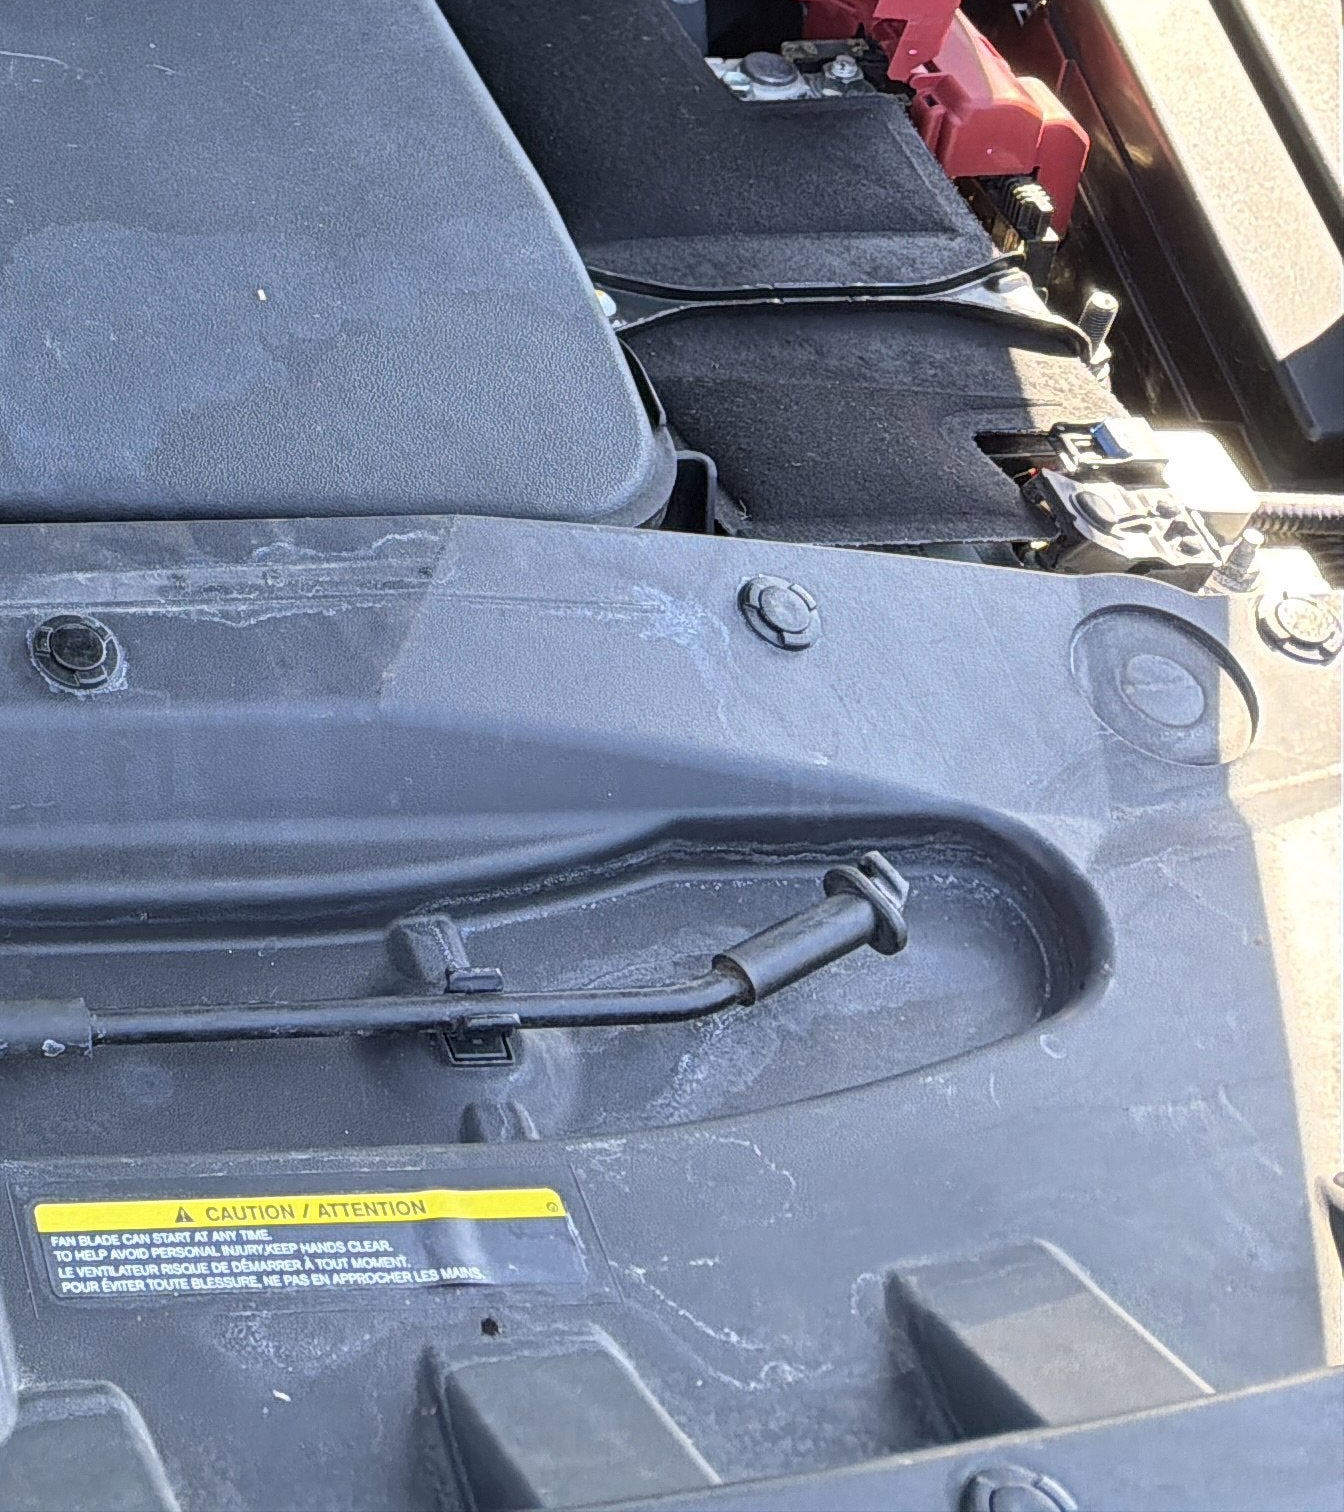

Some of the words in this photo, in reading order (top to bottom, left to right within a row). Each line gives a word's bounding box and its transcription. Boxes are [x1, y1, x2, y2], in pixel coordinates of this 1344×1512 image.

[205, 1203, 296, 1222] CAUTION
[318, 1199, 428, 1219] ATTENTION
[51, 1235, 76, 1248] FAN
[78, 1234, 120, 1246] BLADE
[122, 1233, 151, 1245] CAN
[152, 1231, 191, 1244] START
[194, 1231, 209, 1243] AT
[211, 1230, 237, 1242] ANY
[238, 1228, 273, 1241] TIME.
[53, 1250, 72, 1262] TO
[74, 1248, 108, 1261] HELP
[110, 1247, 150, 1261] AVOID
[151, 1245, 221, 1259] PERSONAL
[300, 1240, 347, 1255] HANDS
[347, 1239, 394, 1253] CLEAR.
[57, 1266, 75, 1279] LE
[75, 1263, 159, 1278] VENTILATEUR
[160, 1261, 210, 1276] RISQUE
[211, 1260, 230, 1274] DE
[230, 1257, 302, 1274] DÉMARRER
[303, 1255, 315, 1271] À
[314, 1257, 349, 1270] TOUT
[350, 1254, 411, 1269] MOMENT.
[62, 1280, 99, 1293] POUR
[100, 1277, 145, 1292] ÉVITER
[145, 1277, 190, 1291] TOUTE
[190, 1275, 263, 1290] BLESSURE,
[263, 1274, 283, 1287] NE
[283, 1272, 311, 1286] PAS
[312, 1272, 332, 1286] EN
[331, 1270, 415, 1285] APPROCHER
[414, 1268, 440, 1283] LES
[439, 1266, 486, 1280] MAINS.
